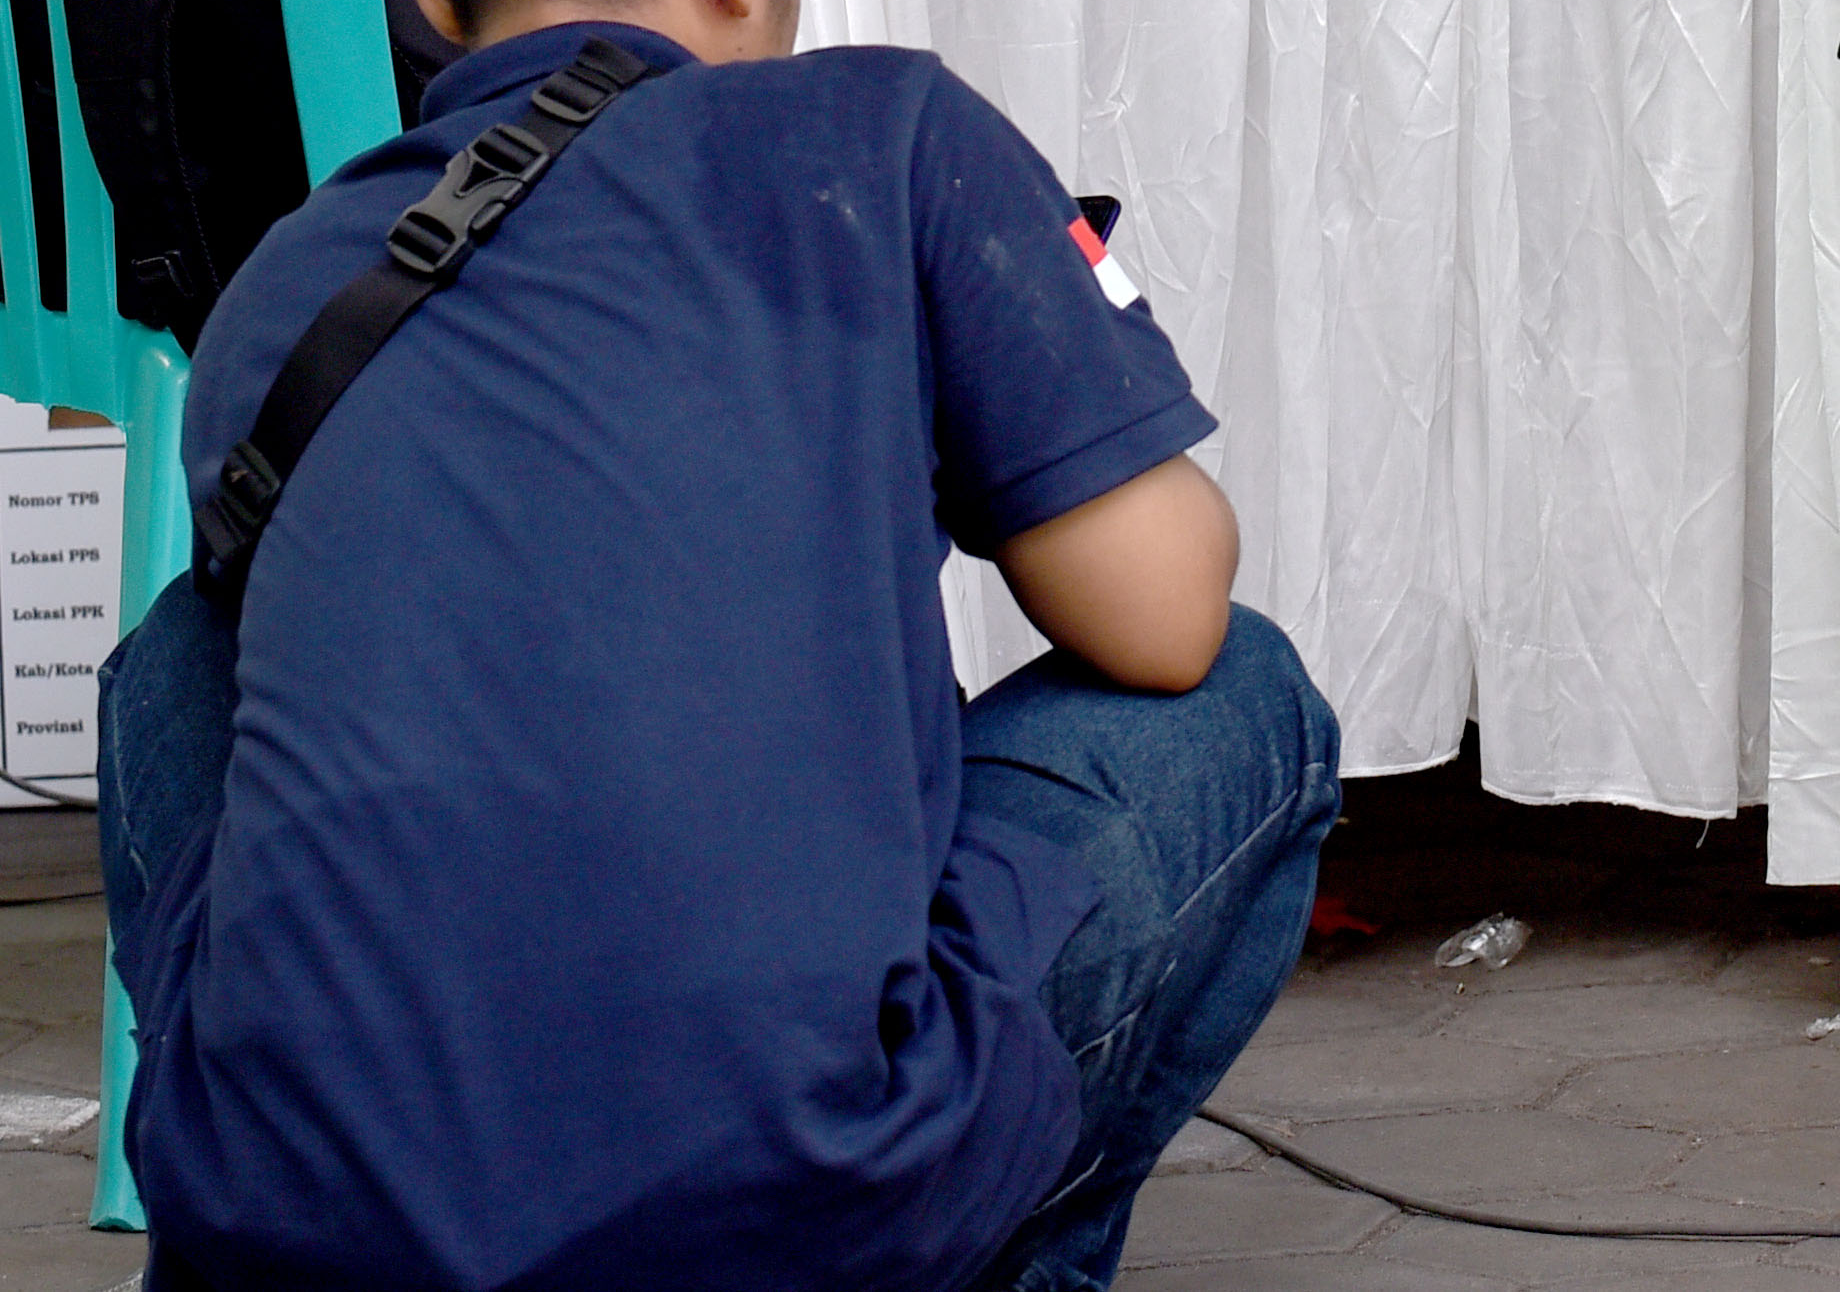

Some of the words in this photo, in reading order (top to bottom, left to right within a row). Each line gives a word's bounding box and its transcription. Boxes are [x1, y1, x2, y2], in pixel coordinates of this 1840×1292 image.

[8, 494, 64, 509] Nomor
[67, 491, 100, 506] TPS
[11, 549, 64, 566] Lokasi
[68, 547, 101, 563] PPS
[12, 605, 66, 622] Lokasi
[70, 604, 105, 618] PPK
[14, 662, 95, 680] Kab/Kota
[16, 719, 85, 736] Provinsi
